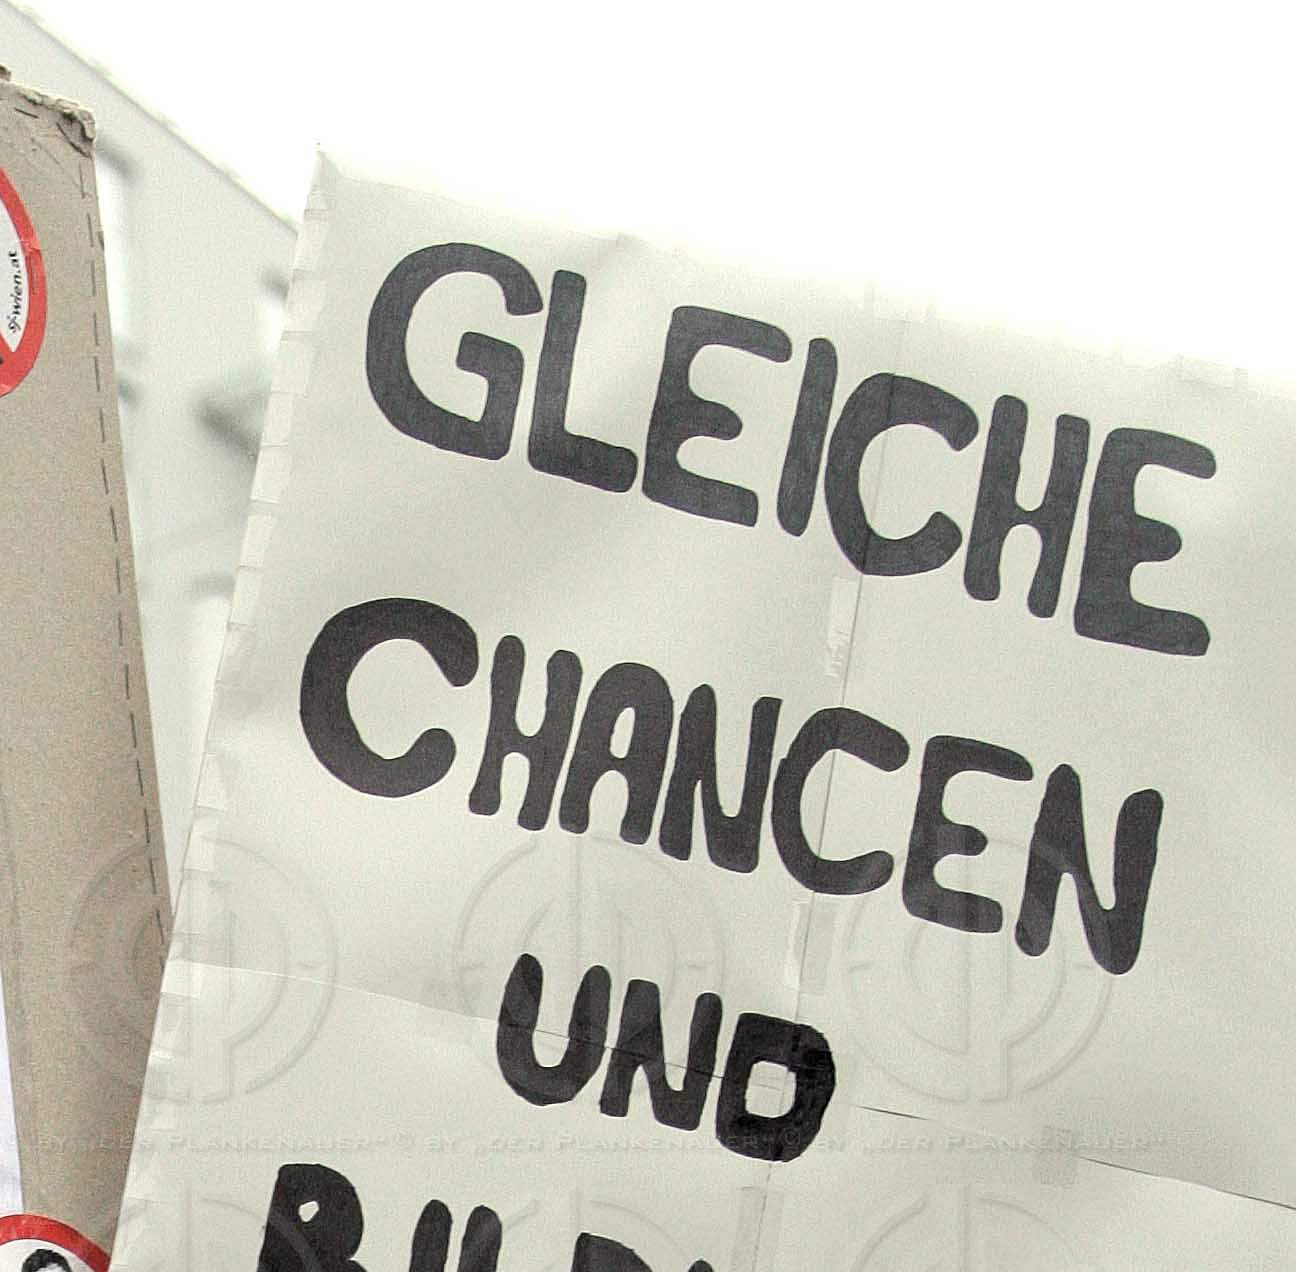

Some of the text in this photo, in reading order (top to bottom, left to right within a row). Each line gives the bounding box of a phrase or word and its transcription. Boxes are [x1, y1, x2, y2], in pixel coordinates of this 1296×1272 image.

[367, 243, 1215, 656] GLEICHE
[300, 598, 1163, 974] CHANCEN
[497, 954, 836, 1162] UND
